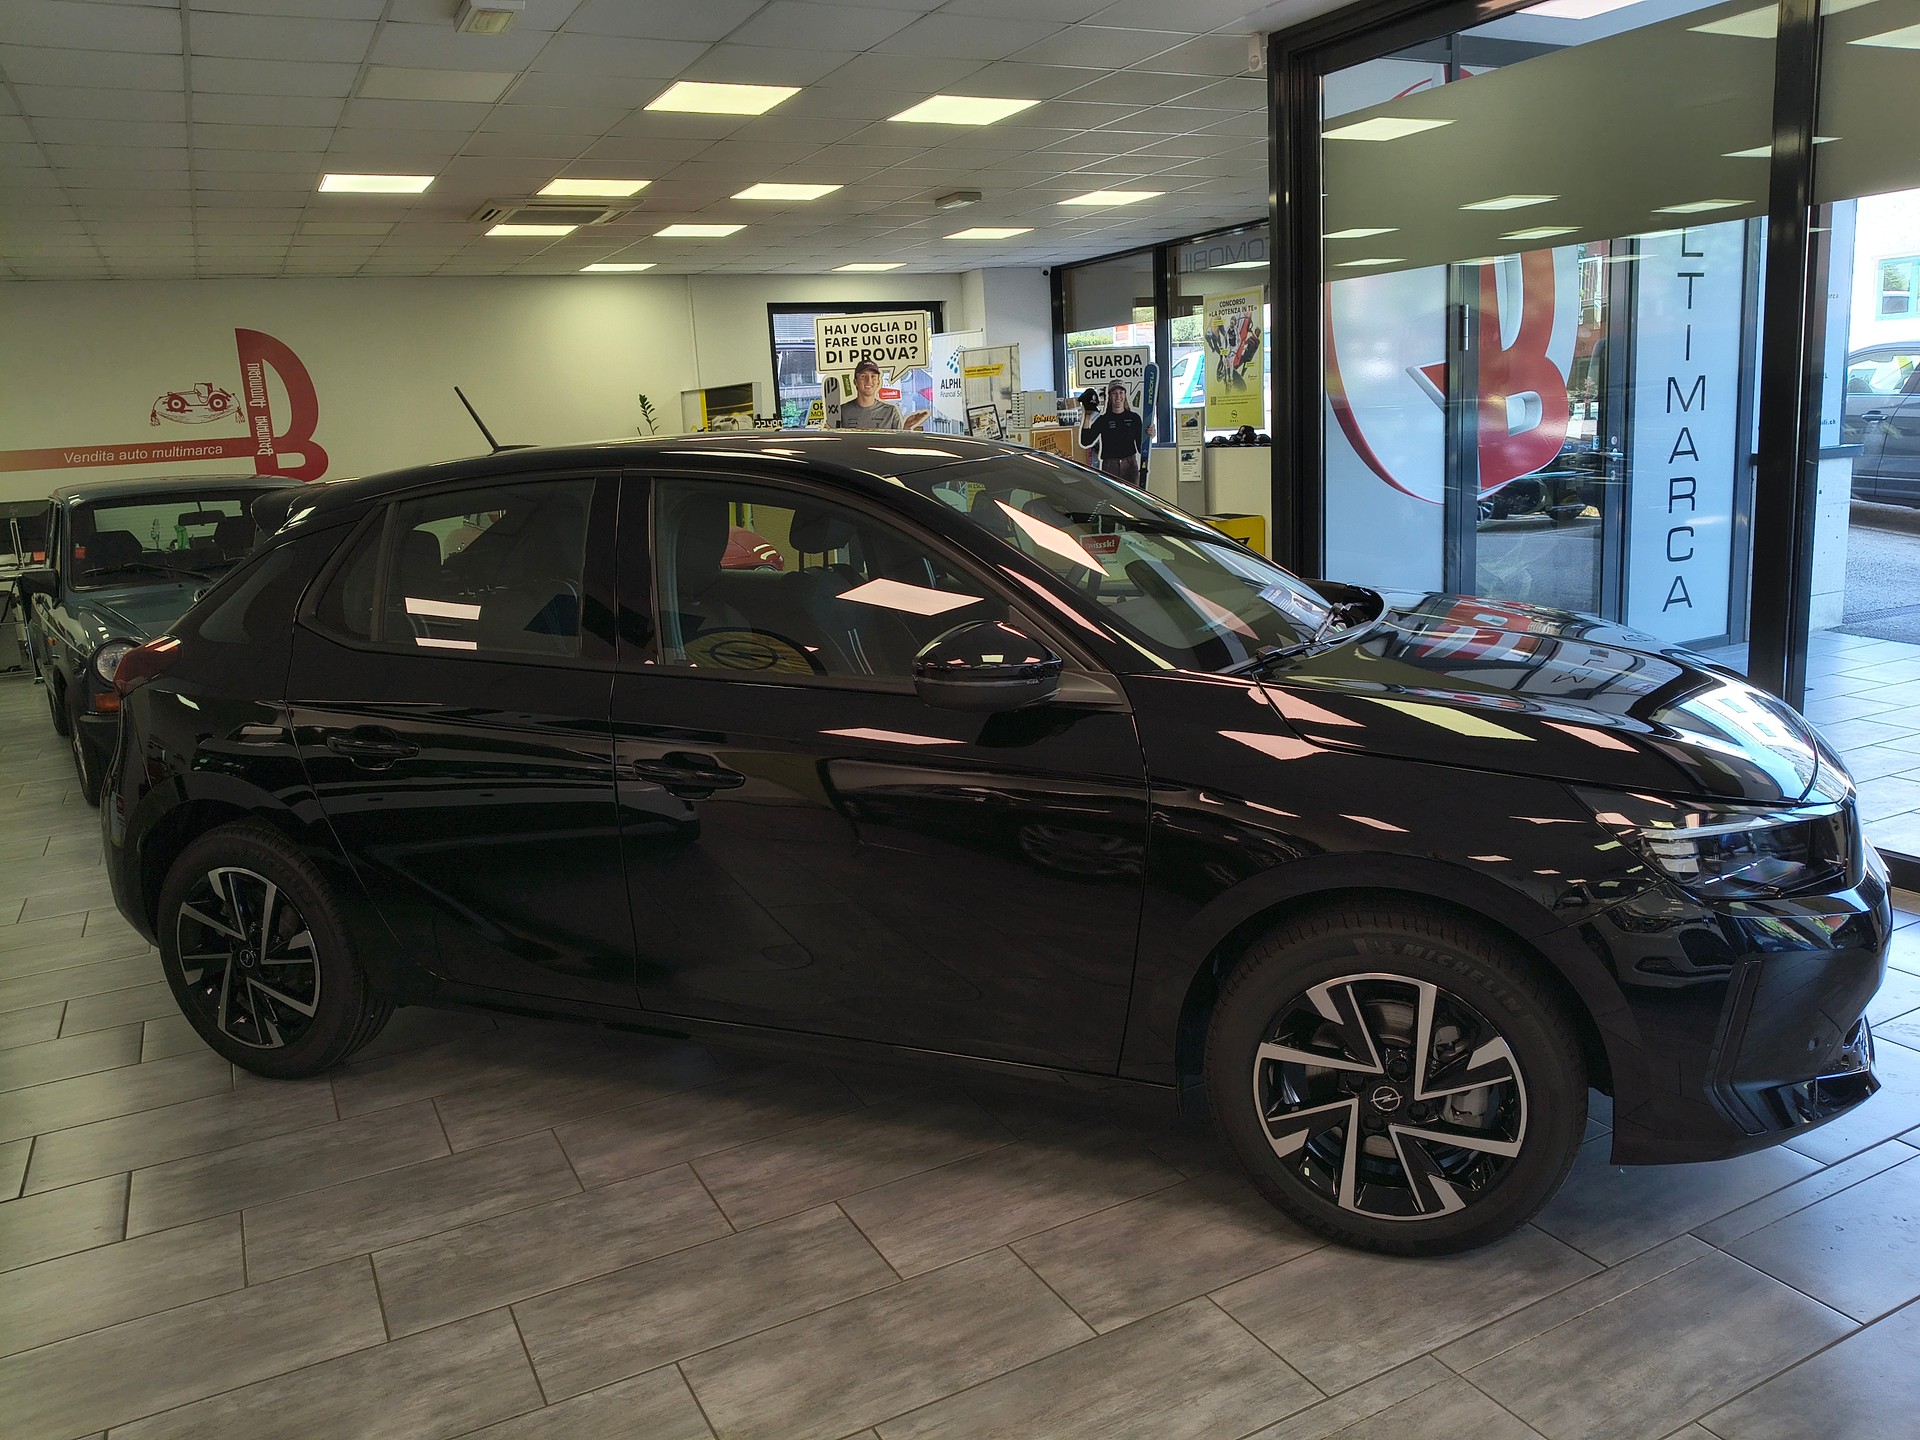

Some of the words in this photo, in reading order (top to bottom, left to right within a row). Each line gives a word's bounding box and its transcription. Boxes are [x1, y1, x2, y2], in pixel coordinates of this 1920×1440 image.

[1219, 297, 1246, 308] CONCORSO
[1218, 307, 1241, 317] POTENZA
[824, 324, 847, 336] HAI
[850, 321, 900, 334] VOGLIA
[904, 320, 917, 331] DI
[824, 336, 858, 348] FARE
[862, 334, 881, 346] UN
[885, 333, 918, 345] GIRO
[826, 350, 843, 364] DI
[849, 346, 918, 363] PROVA?
[1084, 354, 1143, 368] GUARDA
[1084, 369, 1106, 379] CHE
[1109, 367, 1143, 378] LOOK!
[254, 415, 274, 457] BRUMANA
[64, 450, 114, 464] Vendita
[119, 449, 148, 461] auto
[152, 445, 223, 459] multimarca
